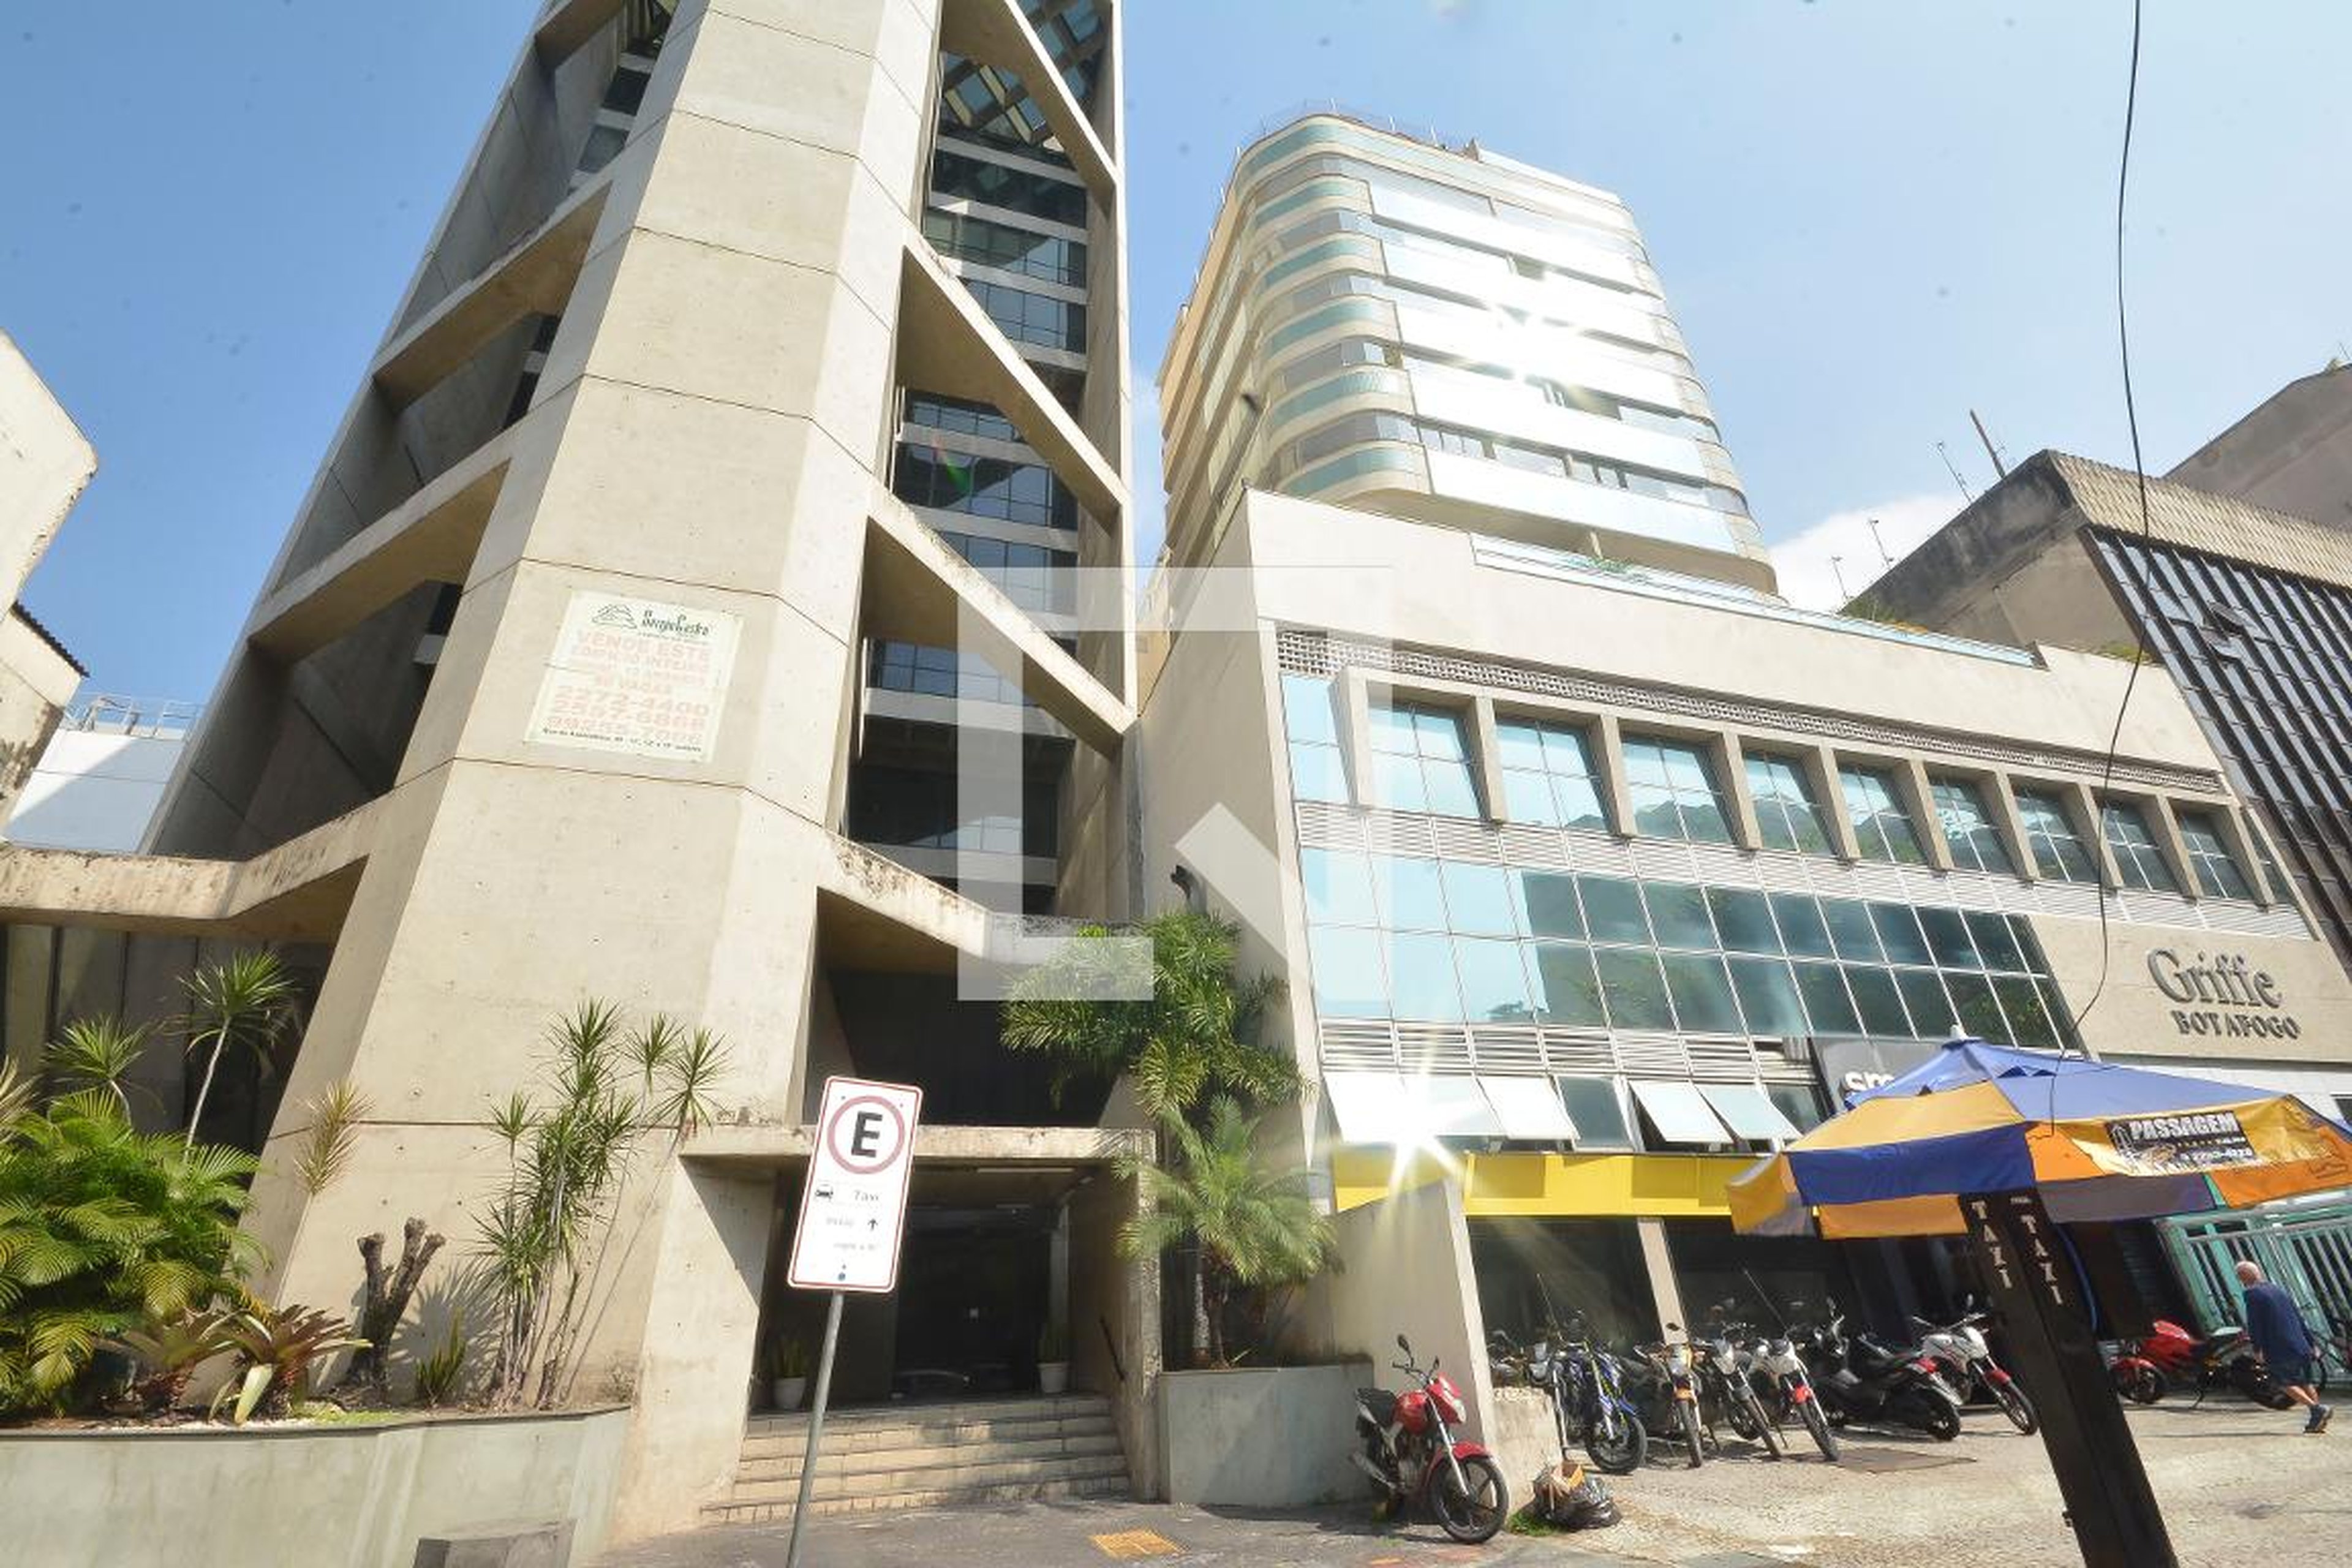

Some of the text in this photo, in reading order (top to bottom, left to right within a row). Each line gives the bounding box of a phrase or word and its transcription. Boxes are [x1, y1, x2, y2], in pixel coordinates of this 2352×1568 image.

[2147, 949, 2283, 1009] Griffe
[2171, 1010, 2302, 1039] BOTAFOGO
[851, 1110, 883, 1158] E
[2130, 1112, 2240, 1140] PASSAGEM
